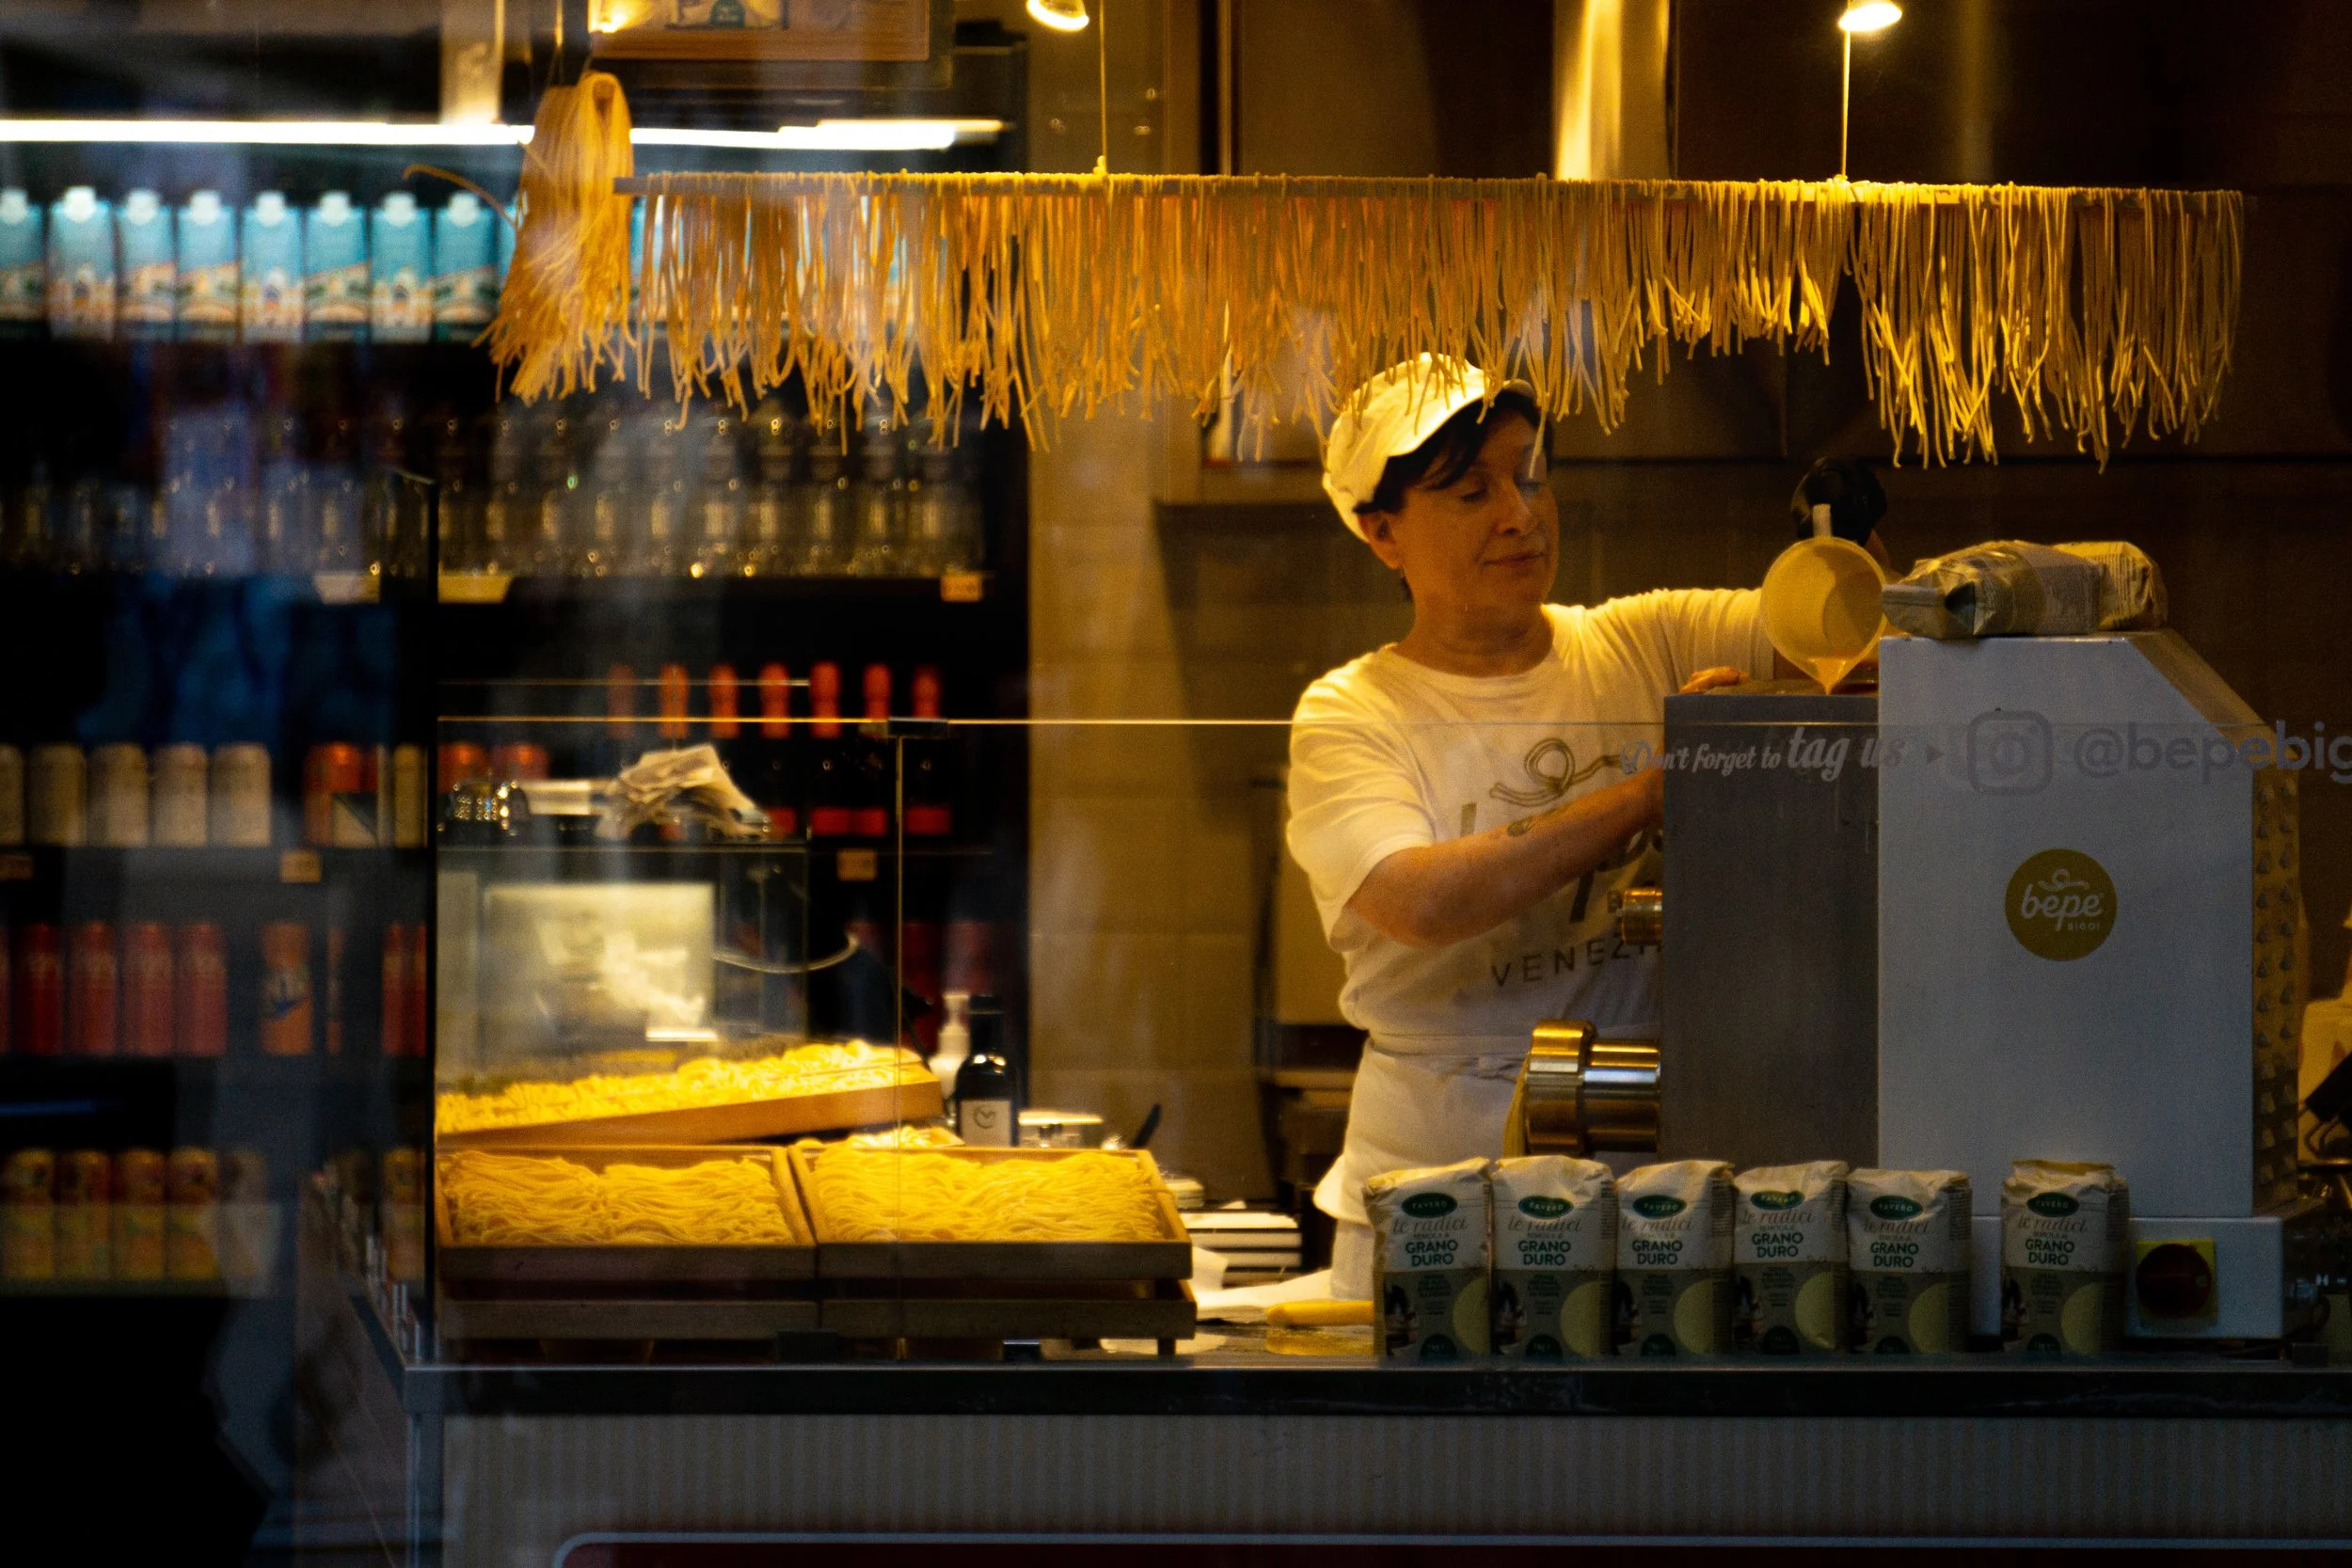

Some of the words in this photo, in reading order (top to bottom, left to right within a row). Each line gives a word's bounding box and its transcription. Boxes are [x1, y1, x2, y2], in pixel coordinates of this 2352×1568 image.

[1618, 738, 1690, 773] Don't
[1692, 743, 1757, 777] forget
[1761, 746, 1781, 768] to
[1788, 727, 1851, 781] tag
[1860, 737, 1906, 768] us
[2020, 883, 2104, 931] bepe
[1760, 1209, 1814, 1224] radici
[1413, 1215, 1470, 1232] radici
[1752, 1232, 1804, 1244] GRANO
[1406, 1240, 1458, 1254] GRANO
[1518, 1240, 1571, 1253] GRANO
[1632, 1240, 1682, 1252] GRANO
[1757, 1245, 1799, 1258] DURO
[1870, 1242, 1919, 1255] GRANO
[2026, 1239, 2074, 1253] GRANO
[1411, 1253, 1454, 1267] DURO
[1523, 1253, 1566, 1266] DURO
[1637, 1253, 1677, 1265] DURO
[1873, 1255, 1914, 1268] DURO
[2028, 1252, 2069, 1265] DURO
